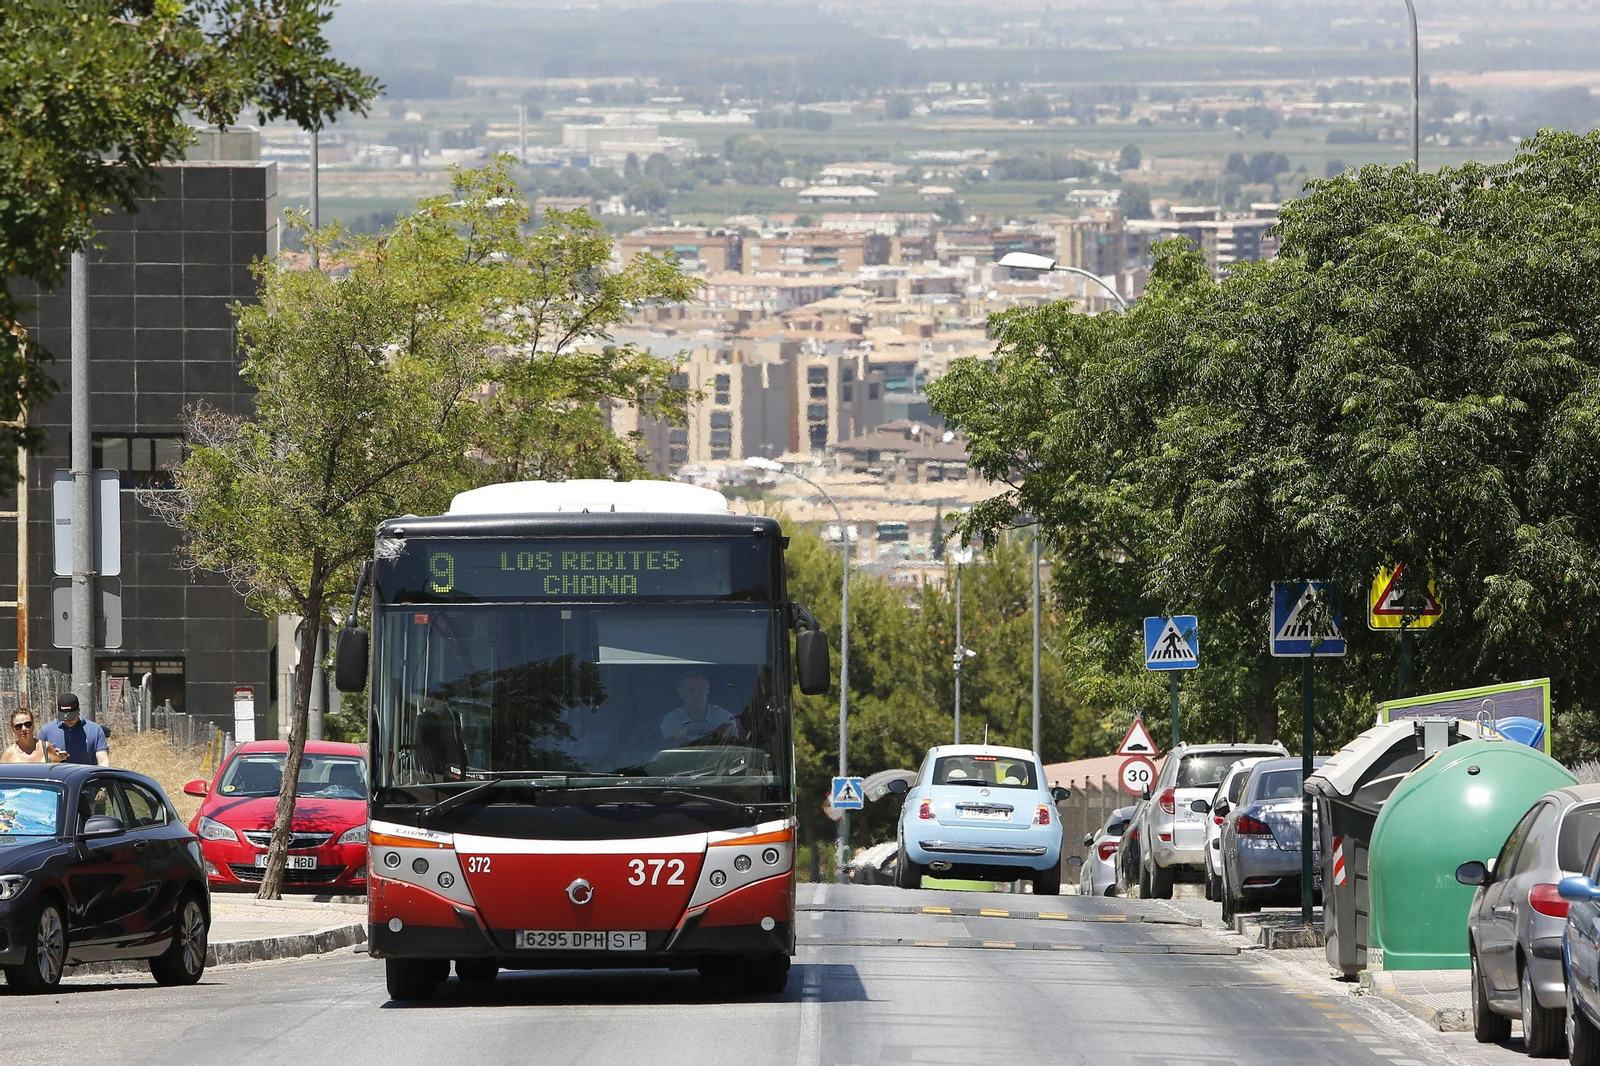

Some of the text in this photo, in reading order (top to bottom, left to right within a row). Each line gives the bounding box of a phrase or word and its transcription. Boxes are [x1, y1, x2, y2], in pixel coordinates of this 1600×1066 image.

[501, 550, 681, 571] LOS REBITES
[429, 552, 455, 593] 9
[544, 574, 637, 594] CHANA
[1128, 769, 1149, 782] 30
[468, 856, 491, 873] 372
[628, 858, 685, 886] 372
[526, 932, 604, 948] 6295 DPH
